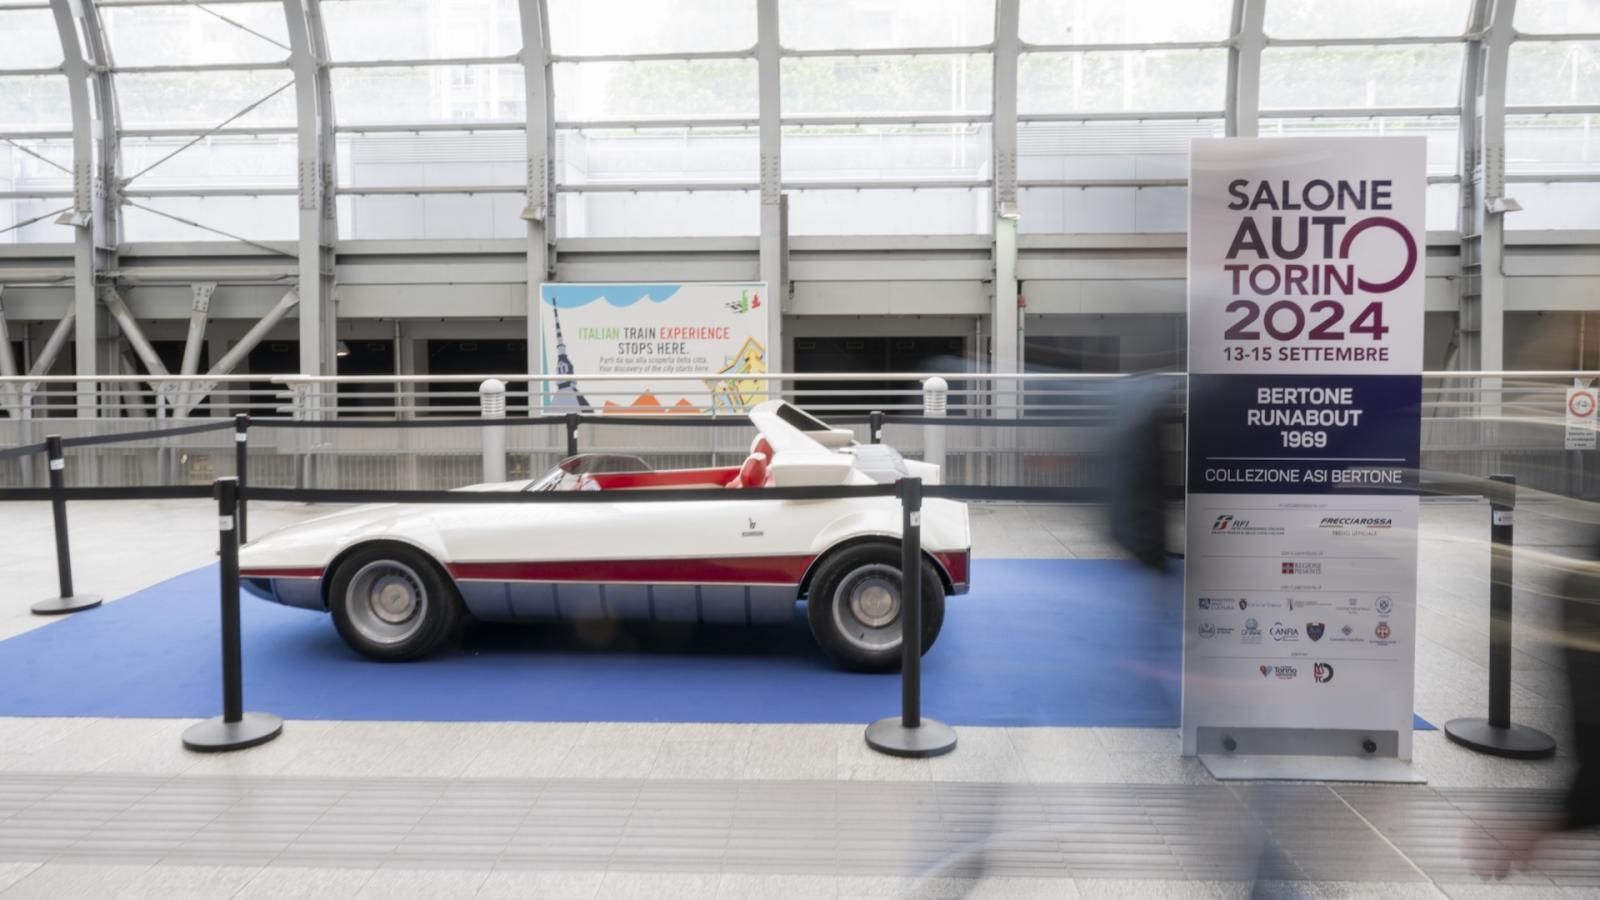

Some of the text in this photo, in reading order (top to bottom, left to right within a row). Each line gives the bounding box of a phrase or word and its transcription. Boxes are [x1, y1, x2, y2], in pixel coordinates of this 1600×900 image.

[1227, 179, 1393, 211] SALONE
[1224, 299, 1390, 342] 2024
[577, 326, 730, 340] ITALIAN TRAIN EXPERIENCE
[618, 341, 690, 355] STOPS HERE.
[1224, 346, 1390, 361] 13-15 SETTEMBRE
[1257, 387, 1354, 405] BERTONE
[1247, 409, 1363, 427] RUNABOUT
[1280, 430, 1328, 448] 1969
[1205, 468, 1402, 484] COLLEZIONE ASI BERTONE
[1232, 519, 1250, 528] RFI
[1320, 517, 1393, 526] FRECCIAROSSA
